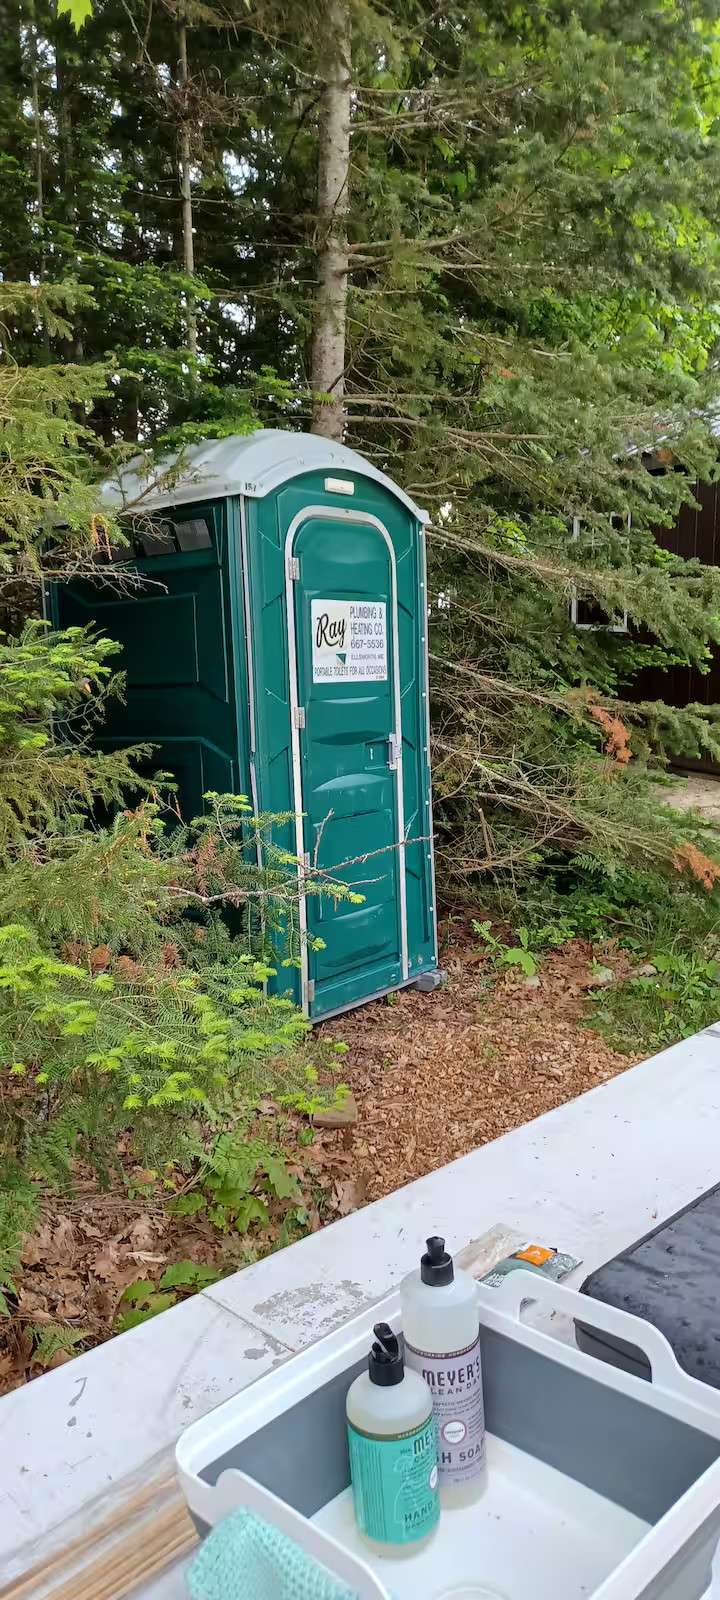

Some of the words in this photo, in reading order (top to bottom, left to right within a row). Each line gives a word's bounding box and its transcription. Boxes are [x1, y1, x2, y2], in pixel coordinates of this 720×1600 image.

[350, 606, 377, 619] PLUMBING
[316, 613, 346, 648] Ray
[351, 622, 373, 636] HEATING
[350, 639, 384, 649] 667-5536
[349, 666, 358, 675] FOR
[430, 1386, 462, 1396] LEAN
